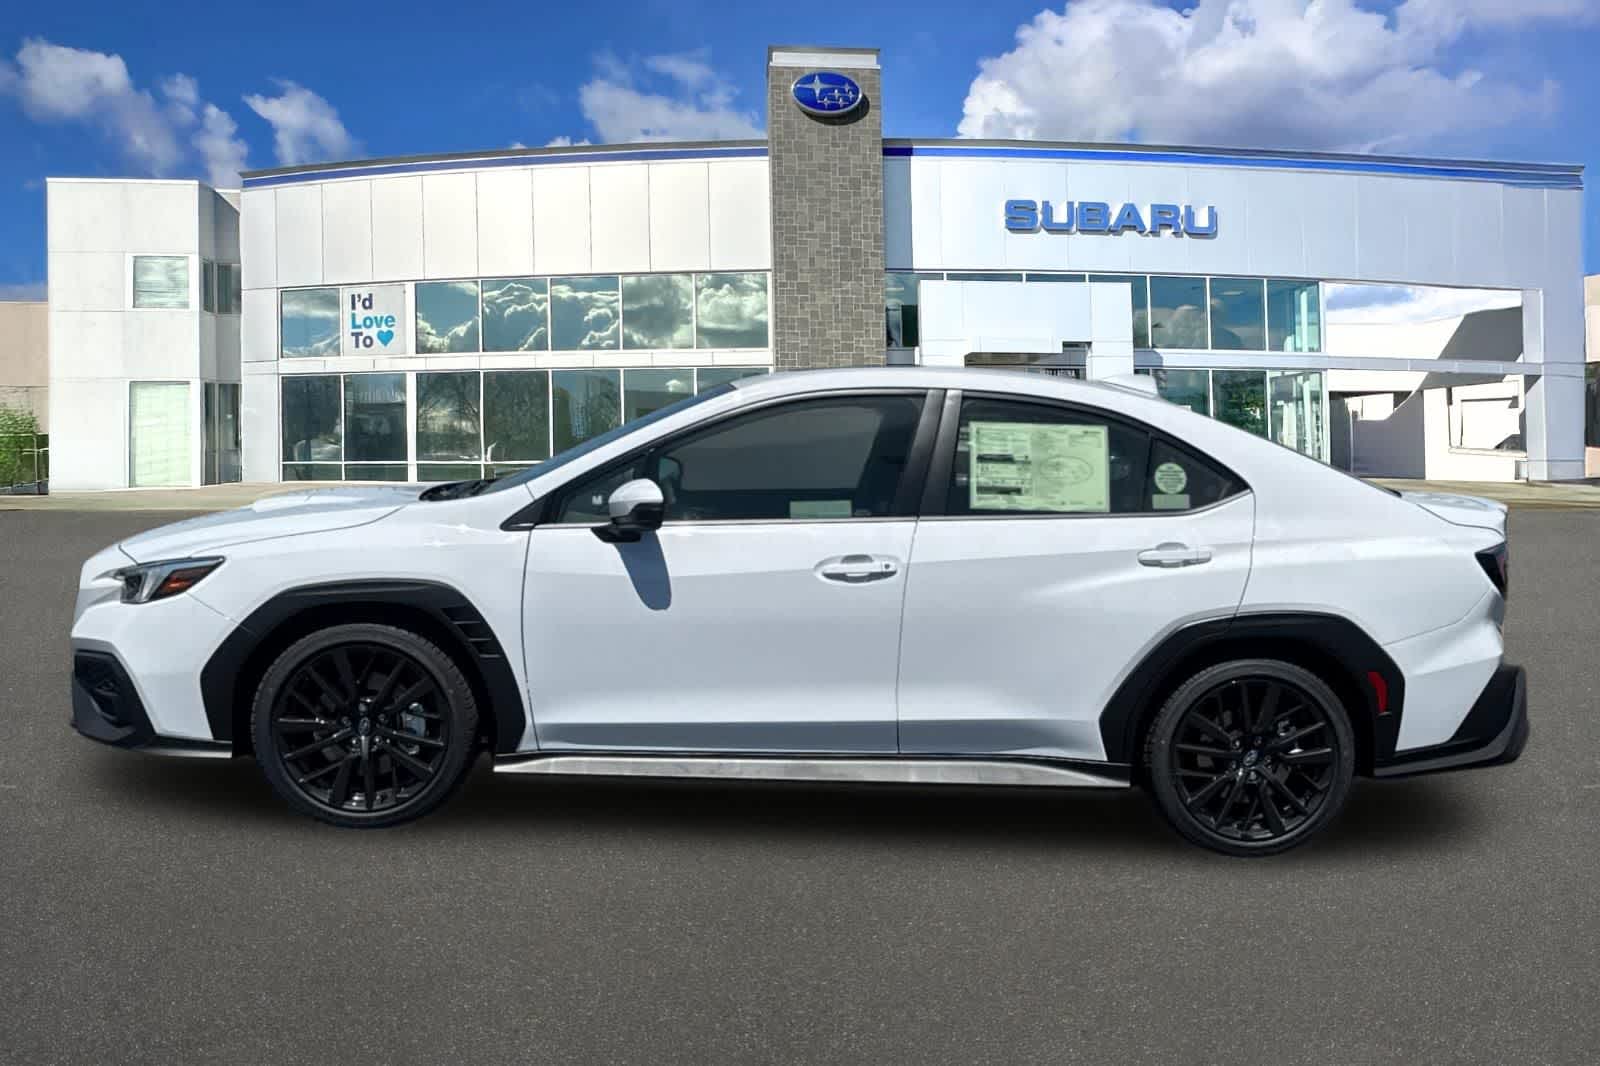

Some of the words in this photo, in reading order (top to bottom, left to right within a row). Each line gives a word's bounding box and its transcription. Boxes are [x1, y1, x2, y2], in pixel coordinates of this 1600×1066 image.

[1005, 199, 1217, 238] SUBARU
[351, 313, 396, 329] Love
[351, 332, 374, 348] To
